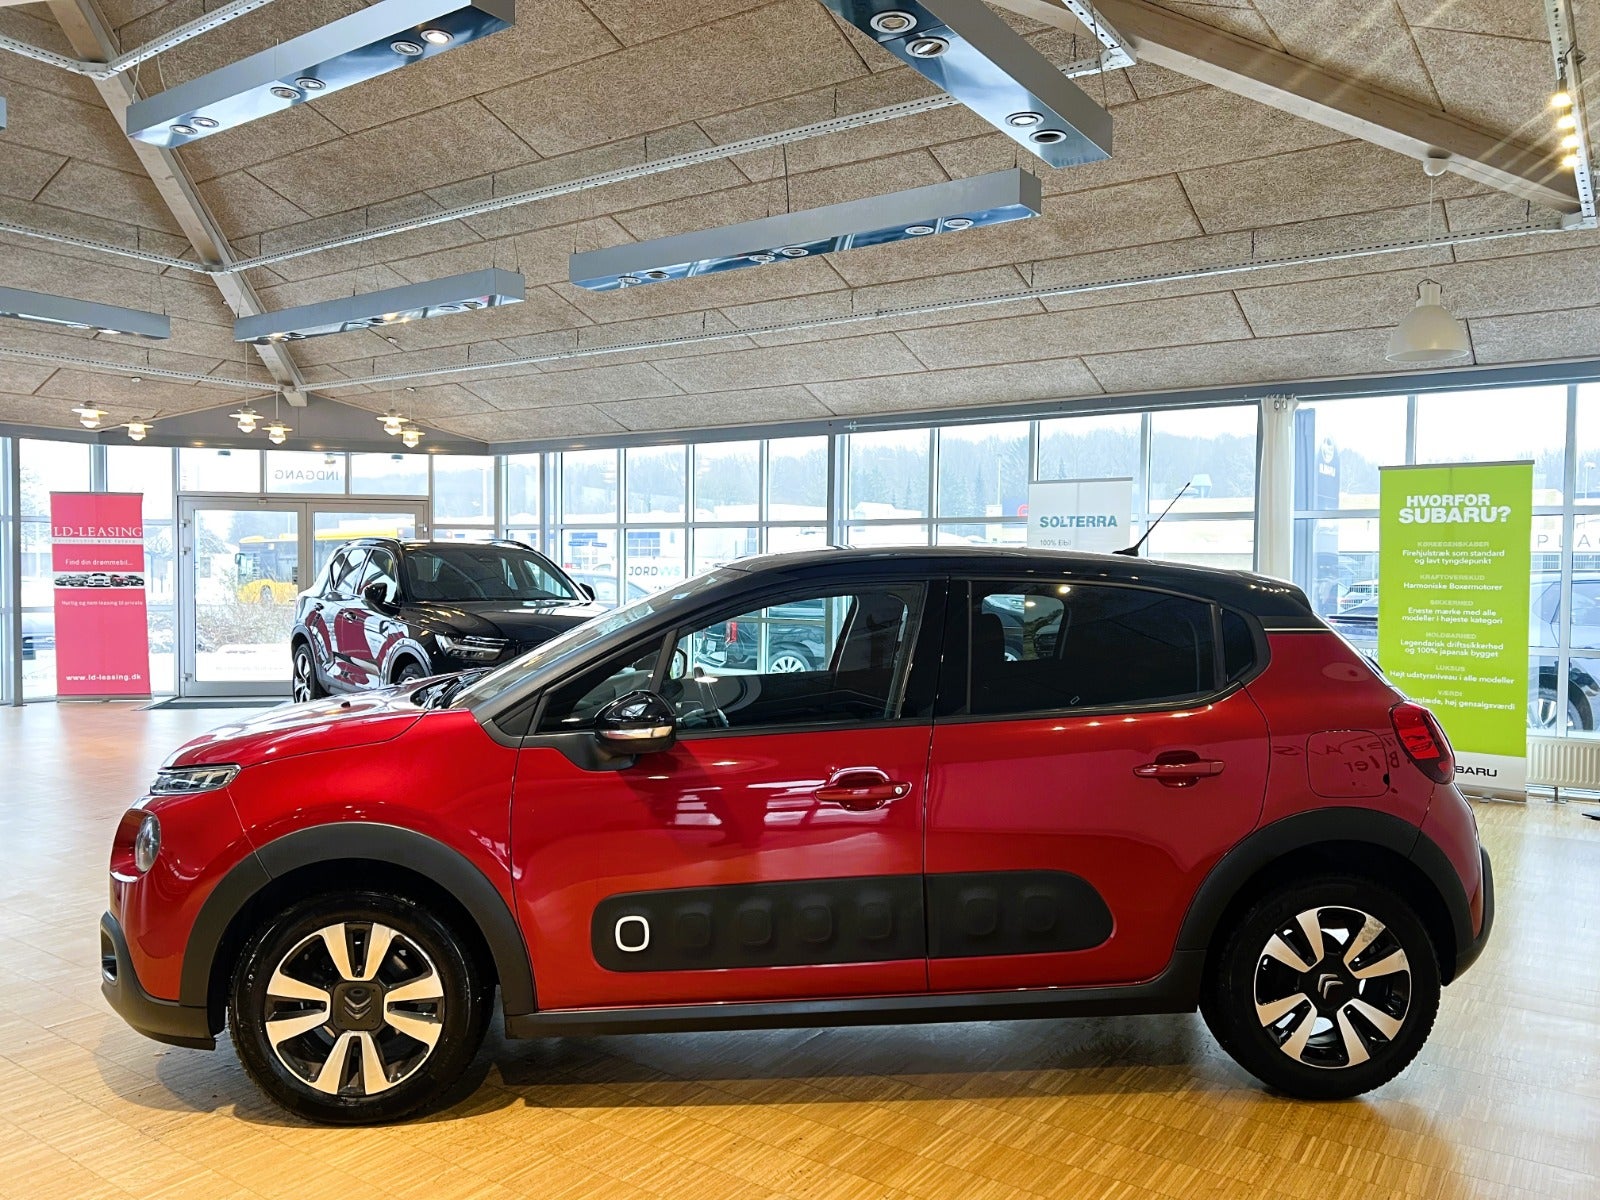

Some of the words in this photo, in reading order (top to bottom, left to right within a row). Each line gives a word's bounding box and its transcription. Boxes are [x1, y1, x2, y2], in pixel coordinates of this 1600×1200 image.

[1406, 494, 1491, 507] HVORFOR
[1398, 506, 1512, 523] SUBARU?
[1040, 515, 1118, 528] SOLTERRA
[54, 526, 142, 537] LD-LEASING
[1537, 534, 1600, 548] PLA
[1402, 550, 1450, 558] Firehjulstræk
[1442, 558, 1492, 566] tyngdepunkt
[1450, 582, 1504, 591] Boxermotorer
[1463, 608, 1480, 616] med
[1441, 615, 1468, 624] højeste
[1470, 616, 1503, 625] kategori
[1400, 639, 1445, 648] Legendarisk
[1446, 640, 1504, 650] driftssikkerhed
[1418, 646, 1438, 654] 100%
[1438, 648, 1468, 656] japansk
[1470, 648, 1498, 658] bygget
[66, 674, 141, 682] www.ld-leasing.dk
[1389, 670, 1406, 678] Højt
[1406, 671, 1458, 682] udstyrsniveau
[1464, 674, 1478, 682] alle
[1479, 676, 1515, 684] modeller
[1445, 698, 1457, 706] høj
[1458, 700, 1516, 710] gensalgsværdi
[1455, 765, 1498, 777] BARU
